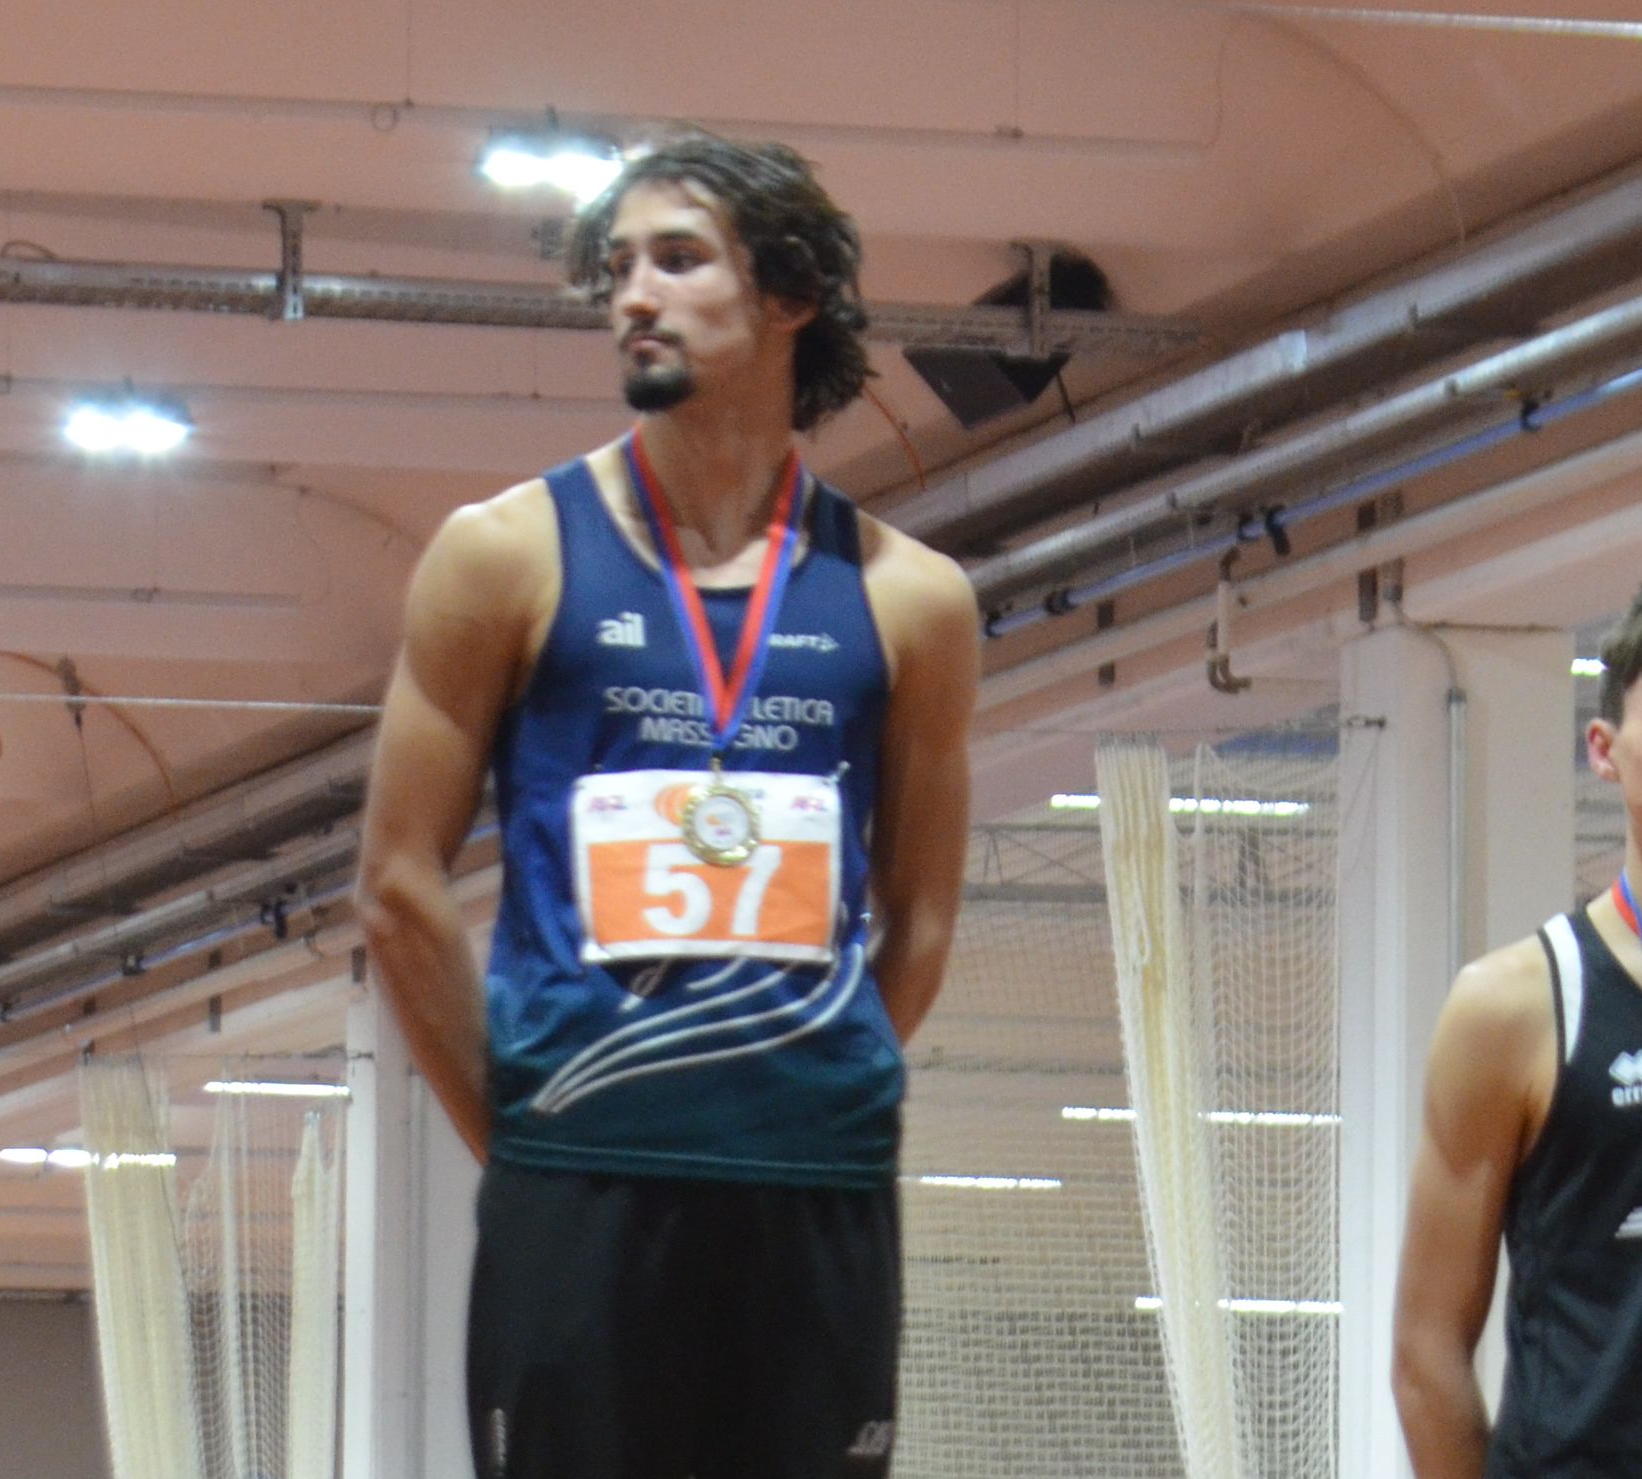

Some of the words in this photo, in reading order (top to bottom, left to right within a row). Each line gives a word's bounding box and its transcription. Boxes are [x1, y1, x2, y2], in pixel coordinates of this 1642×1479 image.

[597, 611, 645, 647] ail
[768, 634, 820, 649] RAFT
[604, 686, 704, 717] SOCIET
[753, 696, 834, 725] LETICA
[639, 716, 799, 751] MASSGNO
[641, 845, 782, 937] 57
